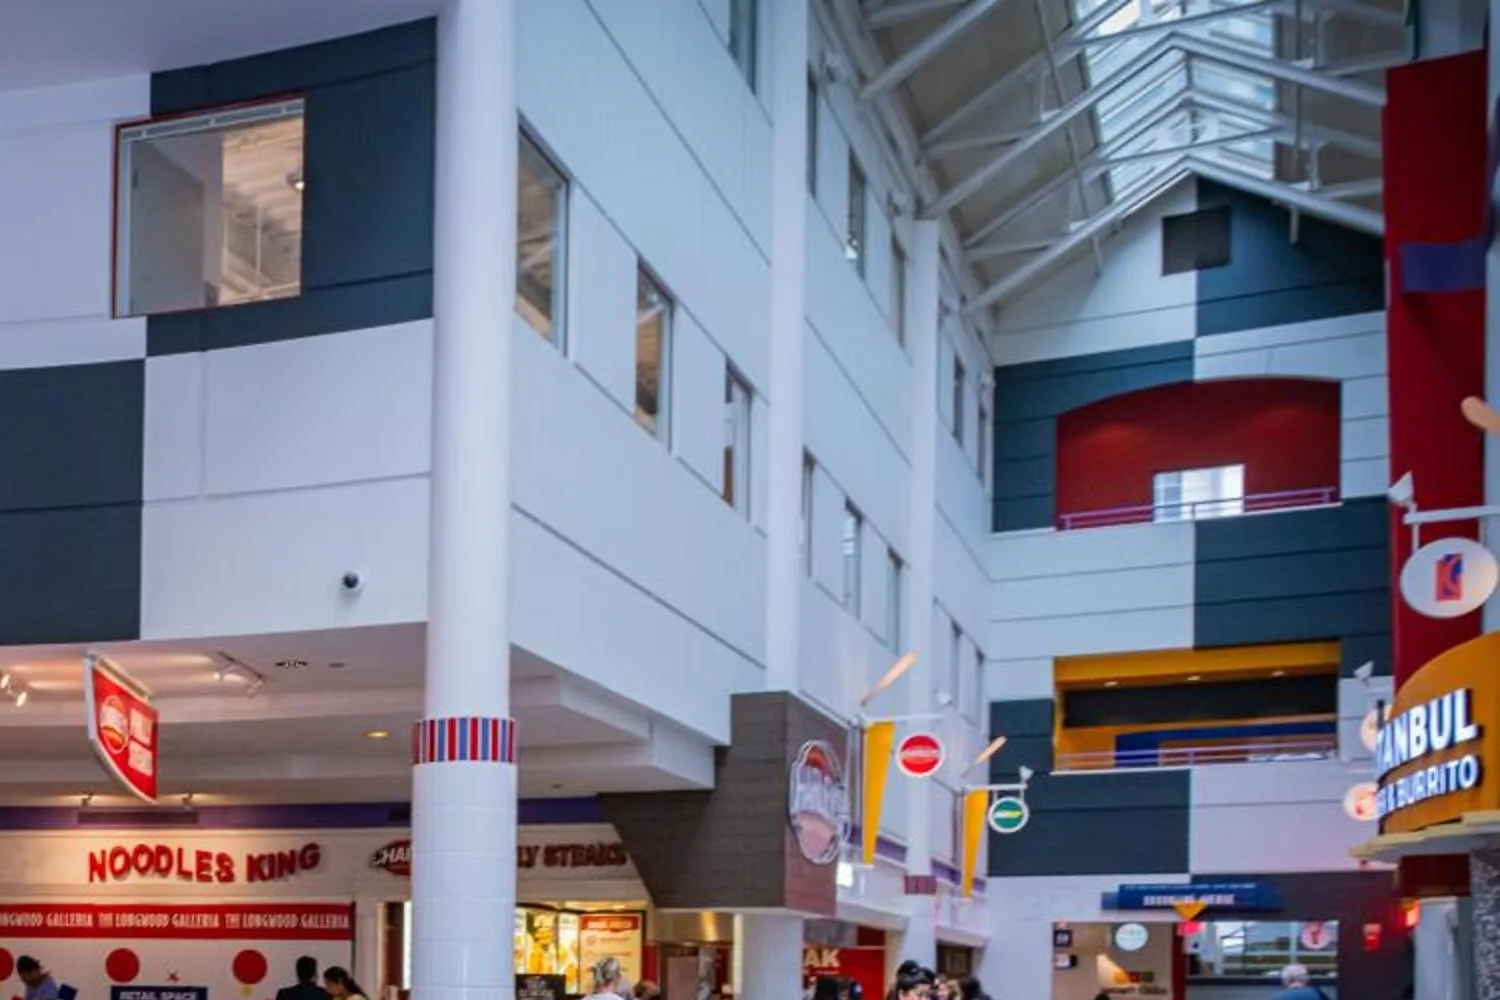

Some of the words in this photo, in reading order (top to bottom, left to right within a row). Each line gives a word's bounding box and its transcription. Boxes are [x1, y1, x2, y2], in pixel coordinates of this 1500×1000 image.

[88, 844, 235, 882] NOODLES
[246, 842, 321, 882] KING
[46, 911, 93, 928] GALLERIA
[98, 912, 113, 928] THE
[115, 912, 169, 928] LONGWOOD
[172, 912, 220, 928] GALLERIA
[225, 913, 240, 928] THE
[243, 913, 298, 928] LONGWOOD
[301, 913, 349, 929] GALLERIA
